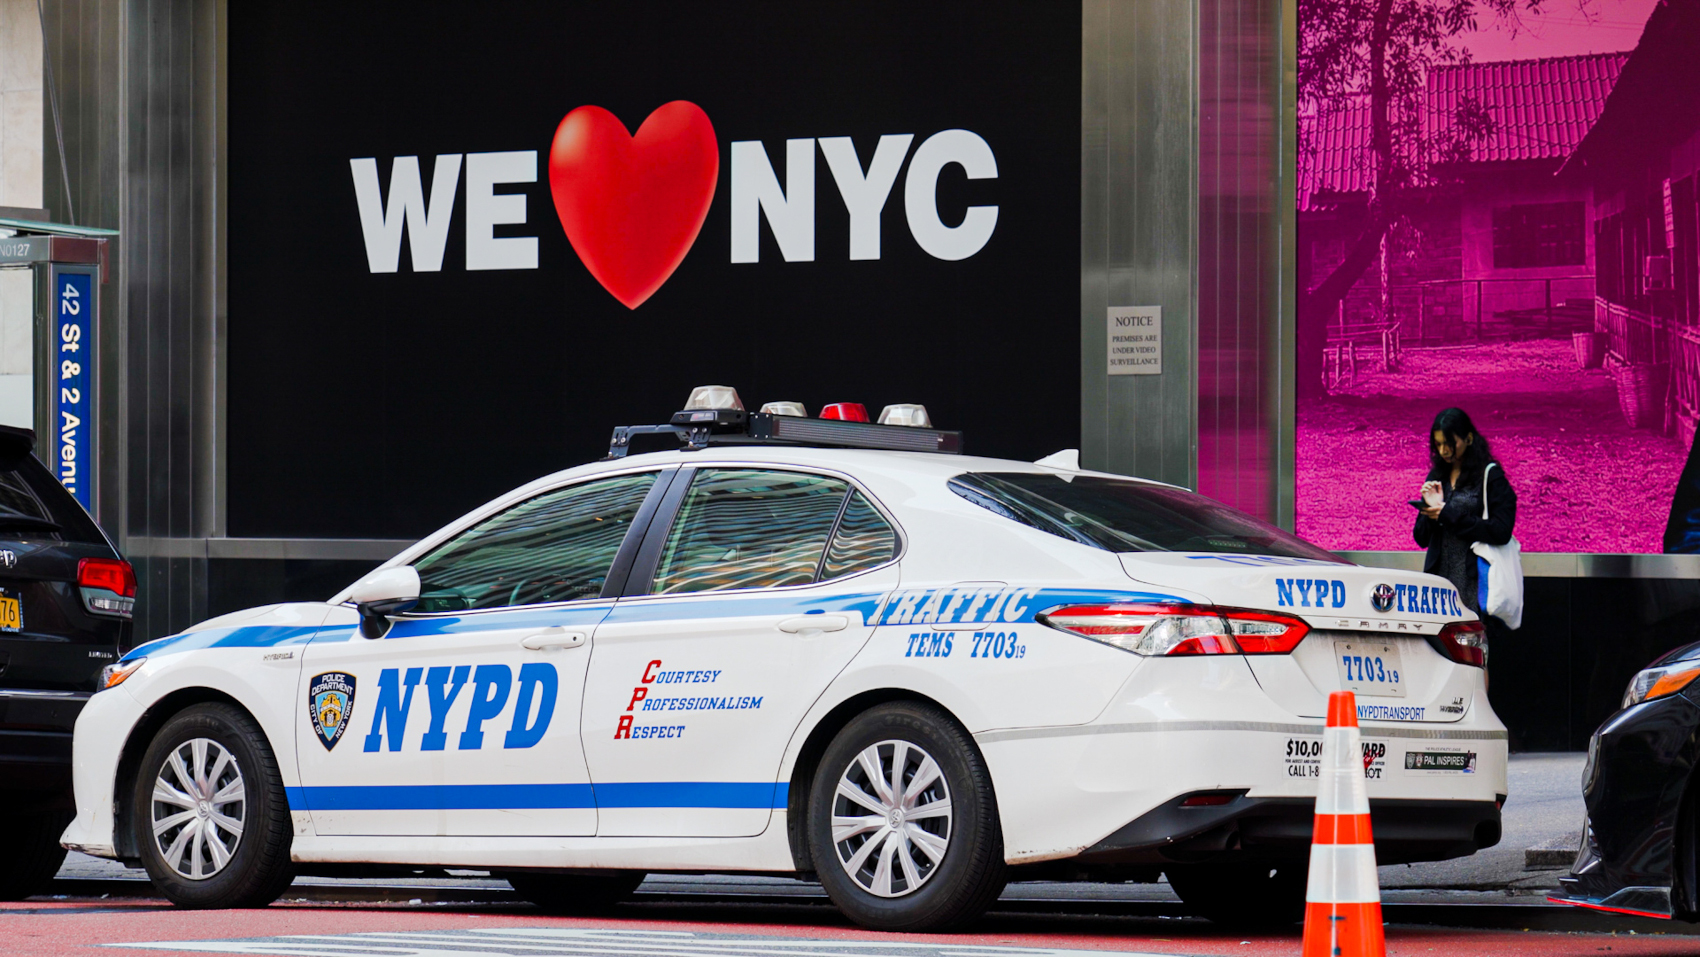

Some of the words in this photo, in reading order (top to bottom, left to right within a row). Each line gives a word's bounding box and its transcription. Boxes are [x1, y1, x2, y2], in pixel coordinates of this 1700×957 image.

[350, 150, 539, 273] WE
[730, 128, 999, 264] NYC
[61, 283, 80, 315] 42
[1115, 316, 1153, 327] NOTICE
[61, 323, 81, 353] St
[1112, 335, 1144, 343] PREMISES
[1135, 346, 1156, 354] VIDEO
[61, 359, 81, 380] &
[1110, 358, 1159, 366] SURVEILLANCE
[61, 387, 80, 404] 2
[61, 411, 80, 494] Avenu
[1275, 578, 1346, 609] NYPD
[1395, 583, 1462, 617] TRAFFIC
[866, 587, 1042, 626] TRAFFIC
[905, 632, 955, 658] TEMS
[322, 673, 346, 683] POLICE
[641, 660, 722, 684] COURTESY
[311, 682, 354, 697] DEPARTMENT
[626, 687, 764, 711] PROFESSIONALISM
[310, 703, 318, 723] CITY
[315, 725, 323, 735] OF
[335, 721, 346, 739] NEW
[344, 700, 353, 720] YORK
[363, 662, 559, 753] NYPD
[1357, 705, 1426, 720] NYPDTRANSPORT
[613, 715, 686, 739] RESPECT
[1286, 738, 1323, 757] $10,0
[1288, 765, 1306, 777] CALL
[1424, 755, 1436, 765] PAL
[1437, 756, 1465, 766] INSPIRES
